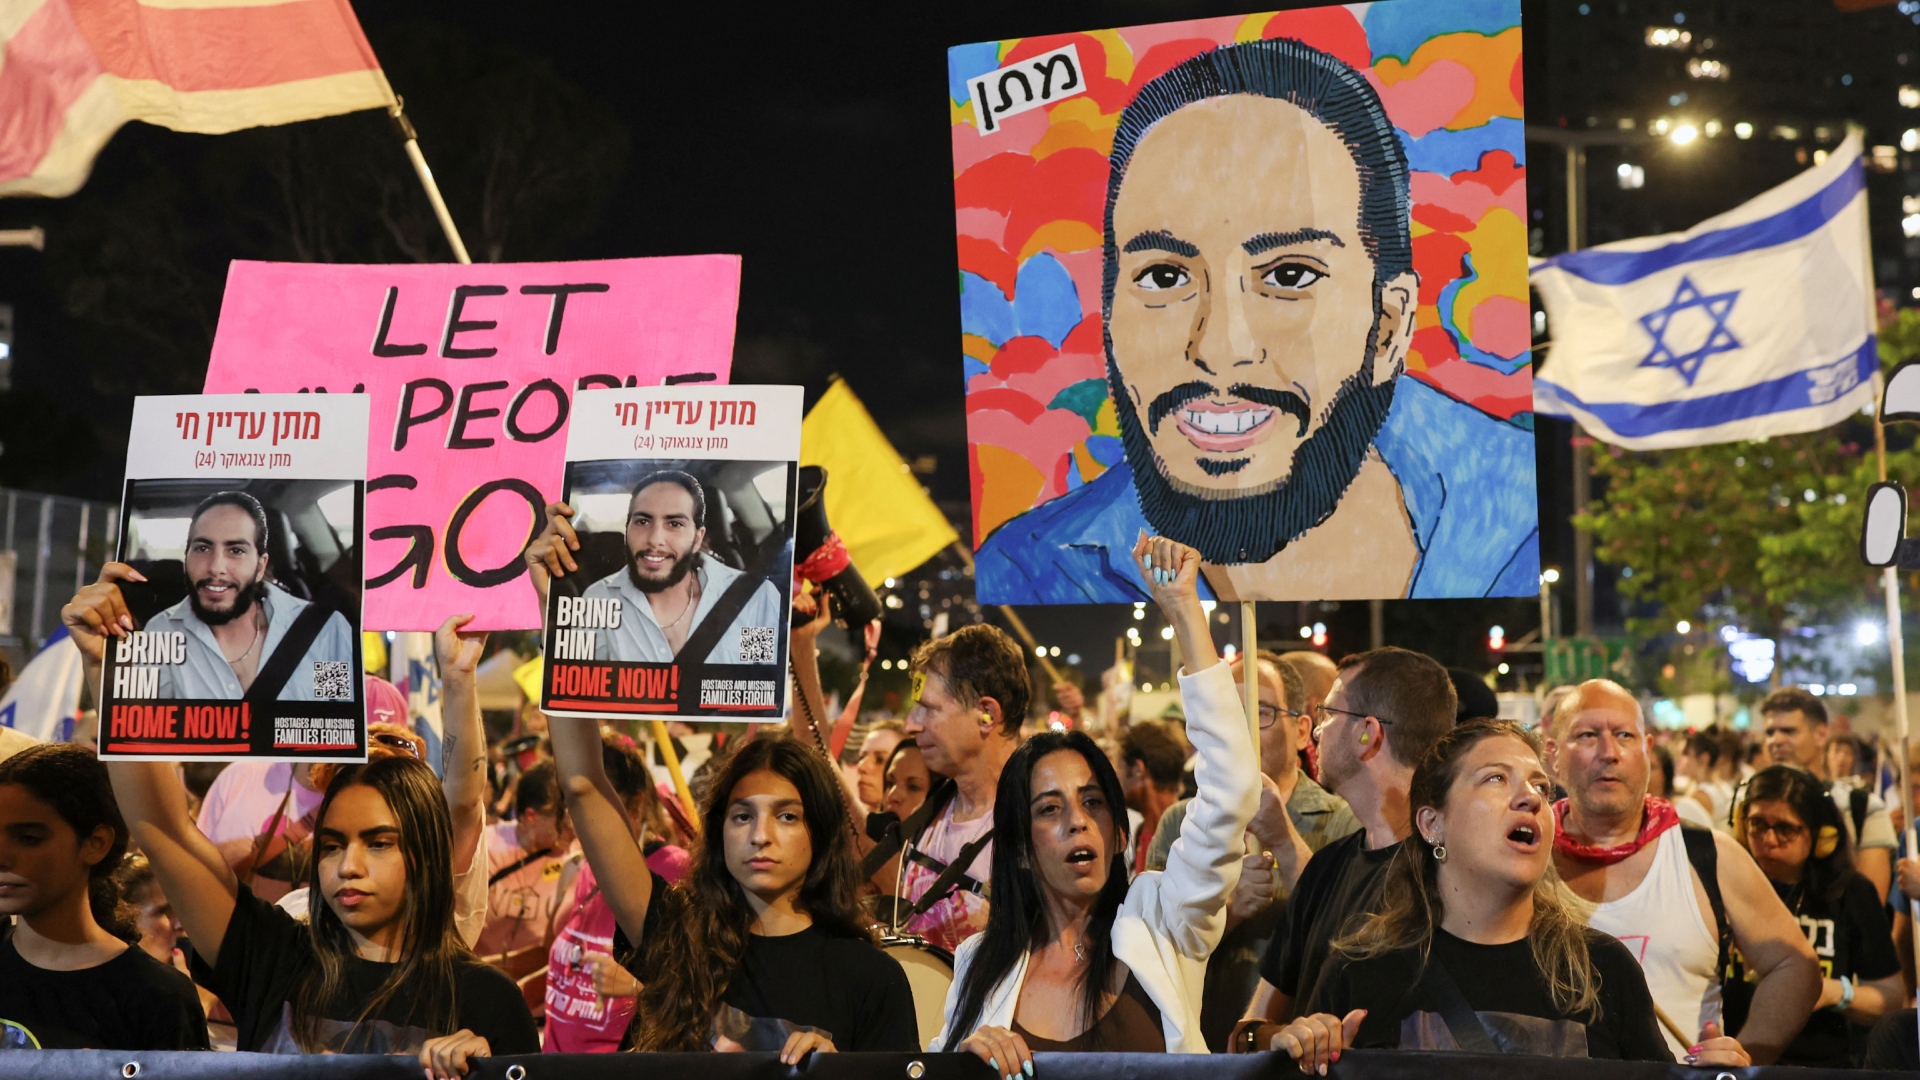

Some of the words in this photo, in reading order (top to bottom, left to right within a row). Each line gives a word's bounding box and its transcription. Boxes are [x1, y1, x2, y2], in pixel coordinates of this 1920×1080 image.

[977, 54, 1077, 130] מתן
[370, 282, 610, 358] LET
[175, 412, 200, 440] חי
[391, 373, 716, 451] PEO
[614, 401, 639, 426] חי
[644, 400, 703, 431] עדיין
[709, 400, 757, 431] מתן
[205, 411, 266, 446] עדיין
[272, 411, 321, 446] מתן
[633, 434, 655, 451] (24)
[658, 436, 704, 451] צנגאוקר
[706, 435, 729, 451] מתן
[194, 450, 216, 469] (24)
[219, 453, 265, 469] צנגאוקר
[269, 453, 292, 469] מתן
[365, 474, 549, 588] GO
[556, 596, 622, 629] BRING
[115, 630, 186, 664] BRING
[553, 629, 597, 661] HIM
[112, 666, 161, 700] HIM
[551, 664, 613, 697] HOME
[617, 664, 680, 700] NOW!
[701, 679, 734, 690] HOSTAGES
[734, 680, 747, 690] AND
[747, 680, 776, 691] MISSING
[700, 690, 742, 706] FAMILIES
[743, 691, 775, 706] FORUM
[110, 704, 179, 739] HOME
[183, 701, 250, 739] NOW!
[274, 717, 310, 729] HOSTAGES
[310, 718, 324, 729] AND
[325, 718, 355, 730] MISSING
[273, 728, 319, 745] FAMILIES
[320, 729, 356, 746] FORUM
